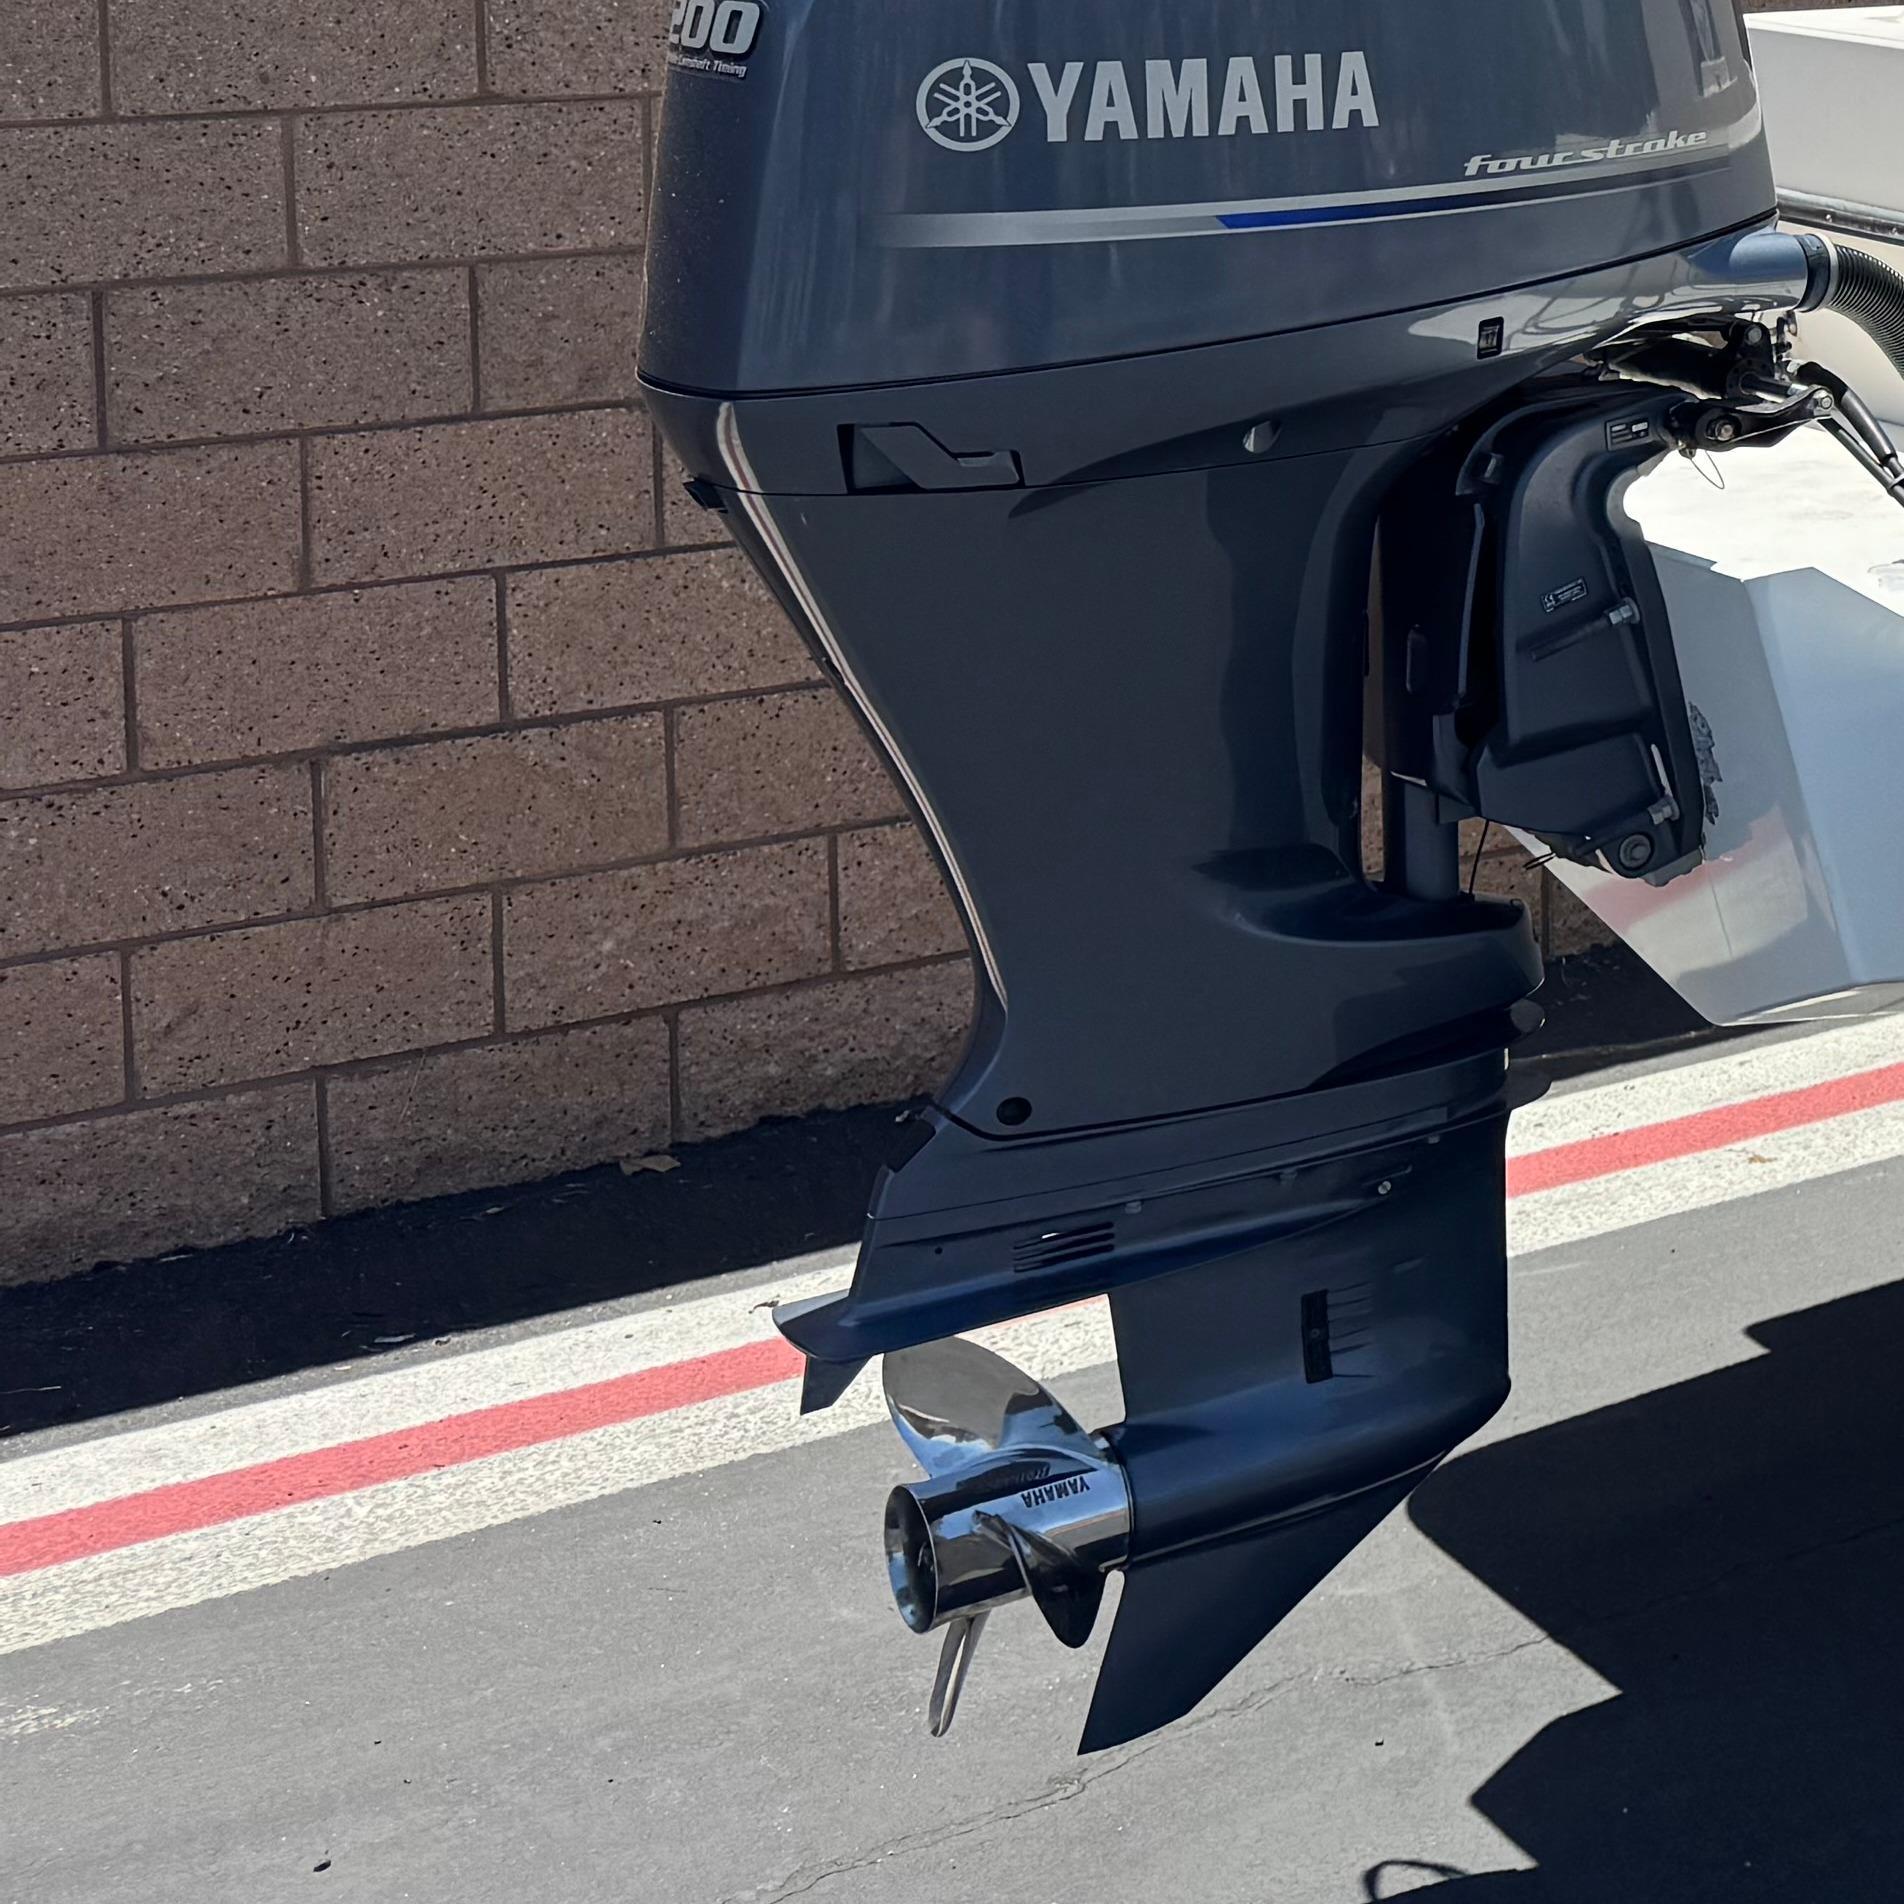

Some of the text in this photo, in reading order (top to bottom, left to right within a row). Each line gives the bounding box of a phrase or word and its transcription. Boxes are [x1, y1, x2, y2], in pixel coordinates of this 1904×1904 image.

[712, 59, 748, 78] Timing
[1027, 51, 1379, 142] YAMAHA
[1020, 1475, 1091, 1509] YAMAHA
